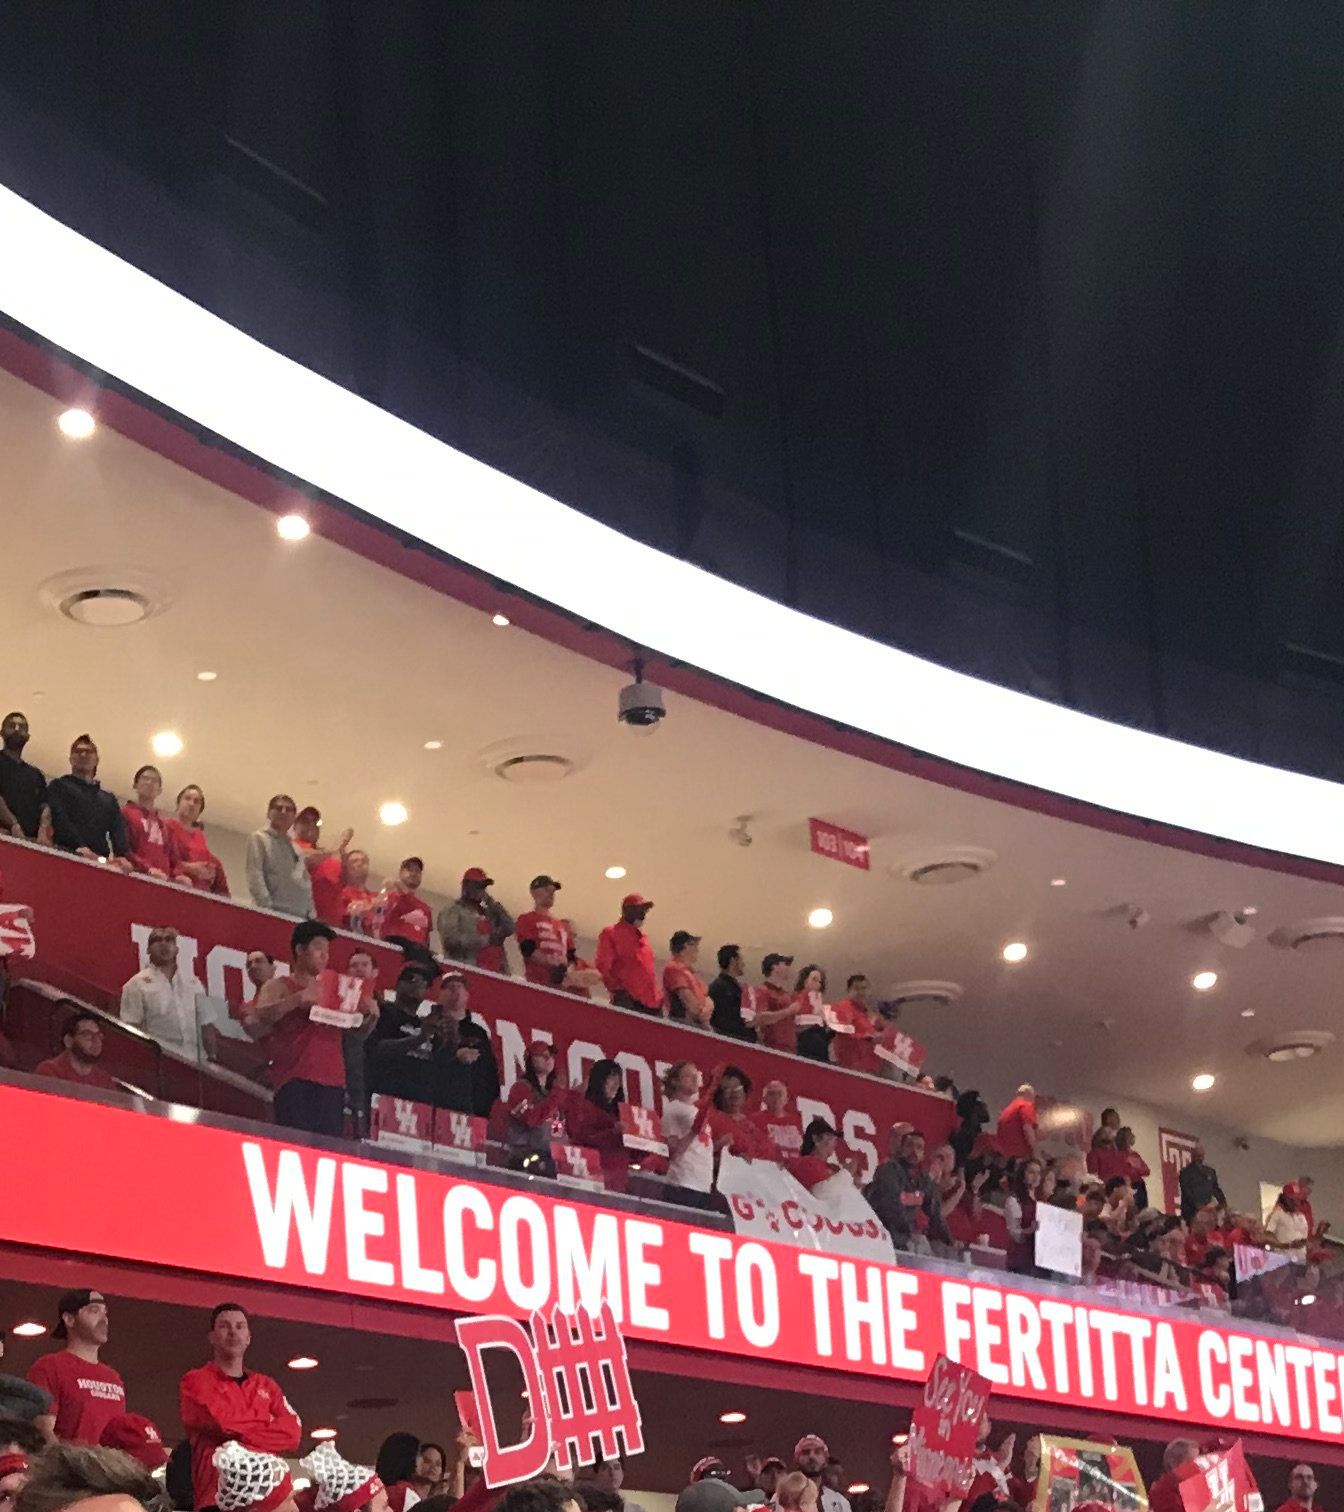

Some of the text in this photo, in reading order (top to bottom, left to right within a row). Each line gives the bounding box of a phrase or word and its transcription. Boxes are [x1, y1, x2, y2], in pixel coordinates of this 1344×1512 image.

[242, 1141, 670, 1331] WELCOME
[689, 1231, 780, 1348] TO
[798, 1253, 925, 1372] THE
[941, 1280, 1189, 1412] FERTITTA
